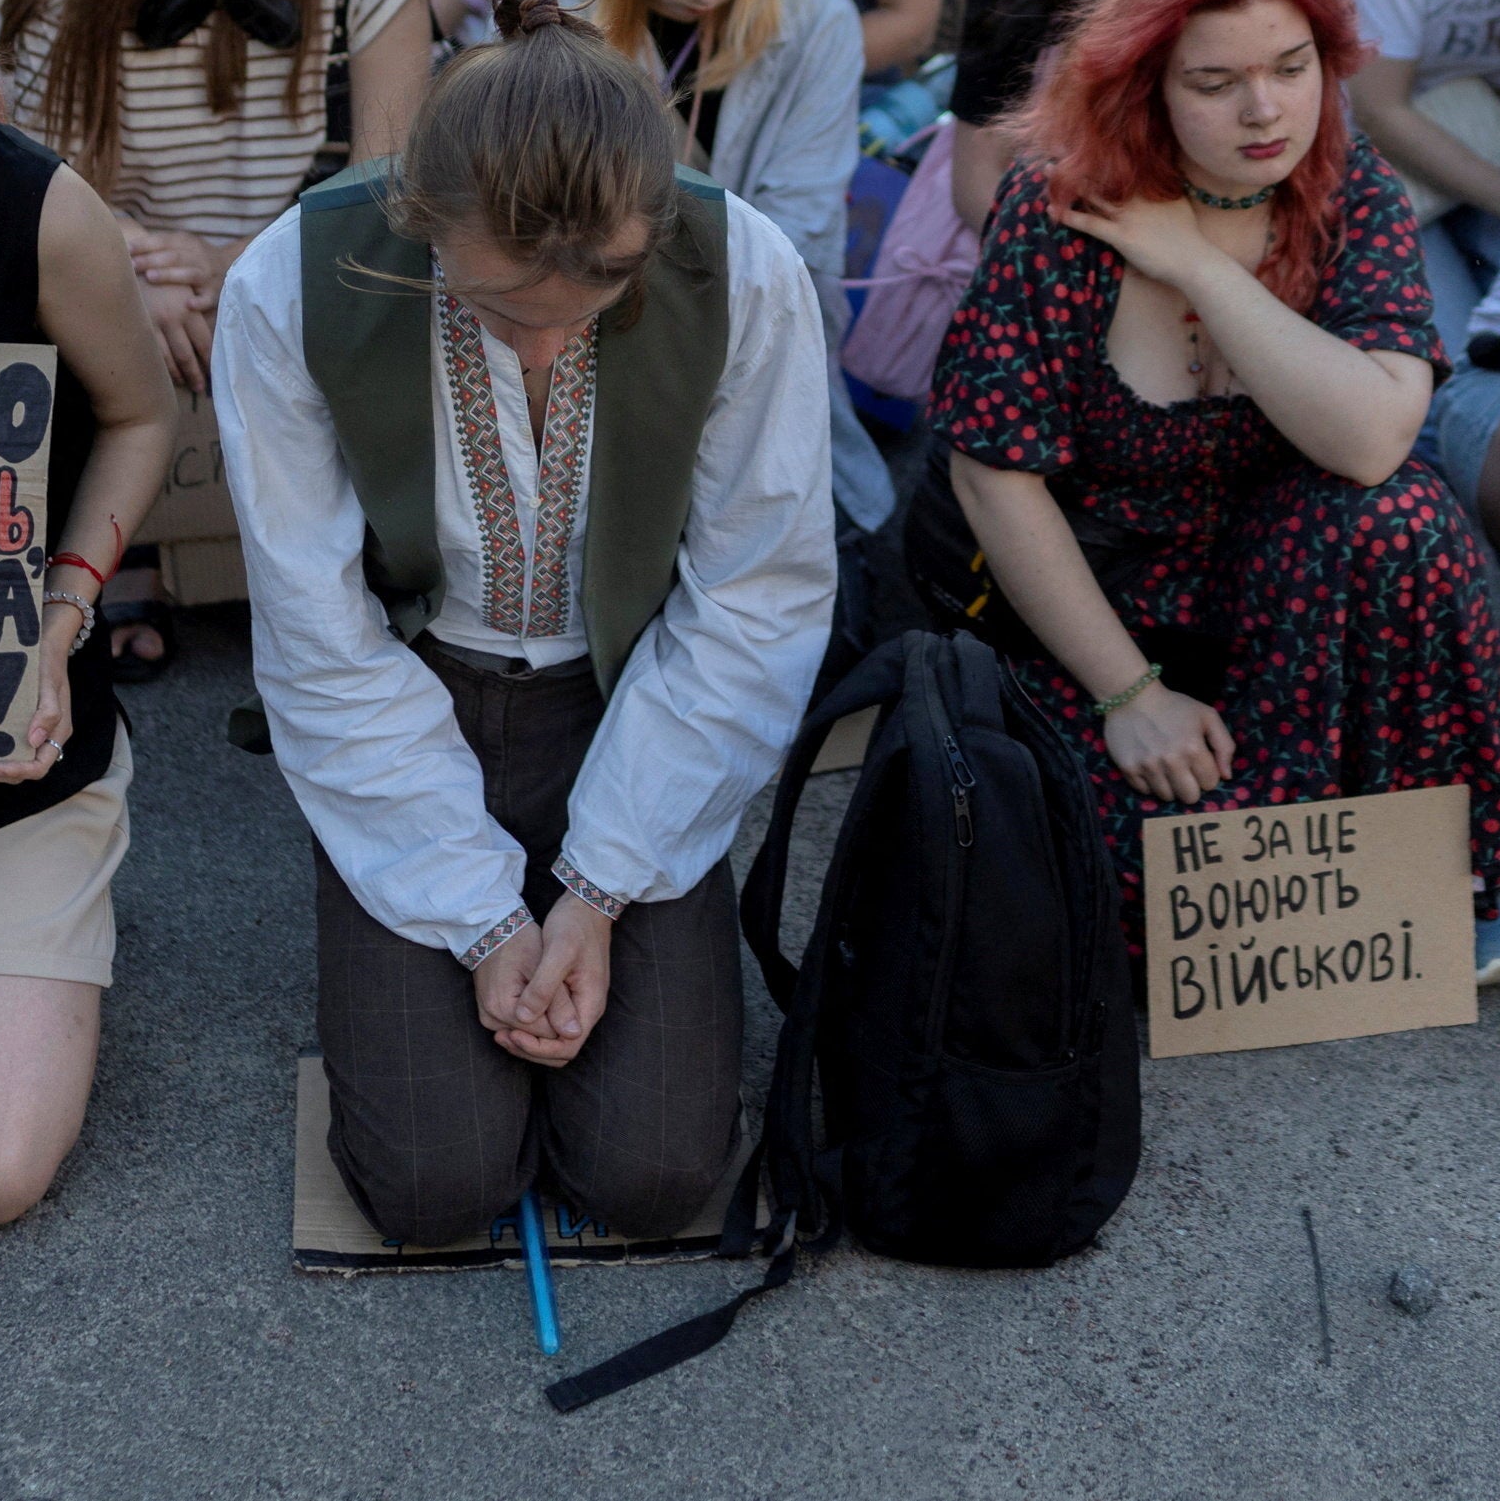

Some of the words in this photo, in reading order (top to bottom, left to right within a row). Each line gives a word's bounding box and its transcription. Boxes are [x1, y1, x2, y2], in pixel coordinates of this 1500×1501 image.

[1172, 821, 1223, 874] НЕ
[1242, 814, 1293, 863] ЗА
[1305, 810, 1357, 863] ЦЕ
[1168, 867, 1360, 941] ВОЮЮТЬ
[1170, 919, 1423, 1020] ВІЙСЬКОВІ.
